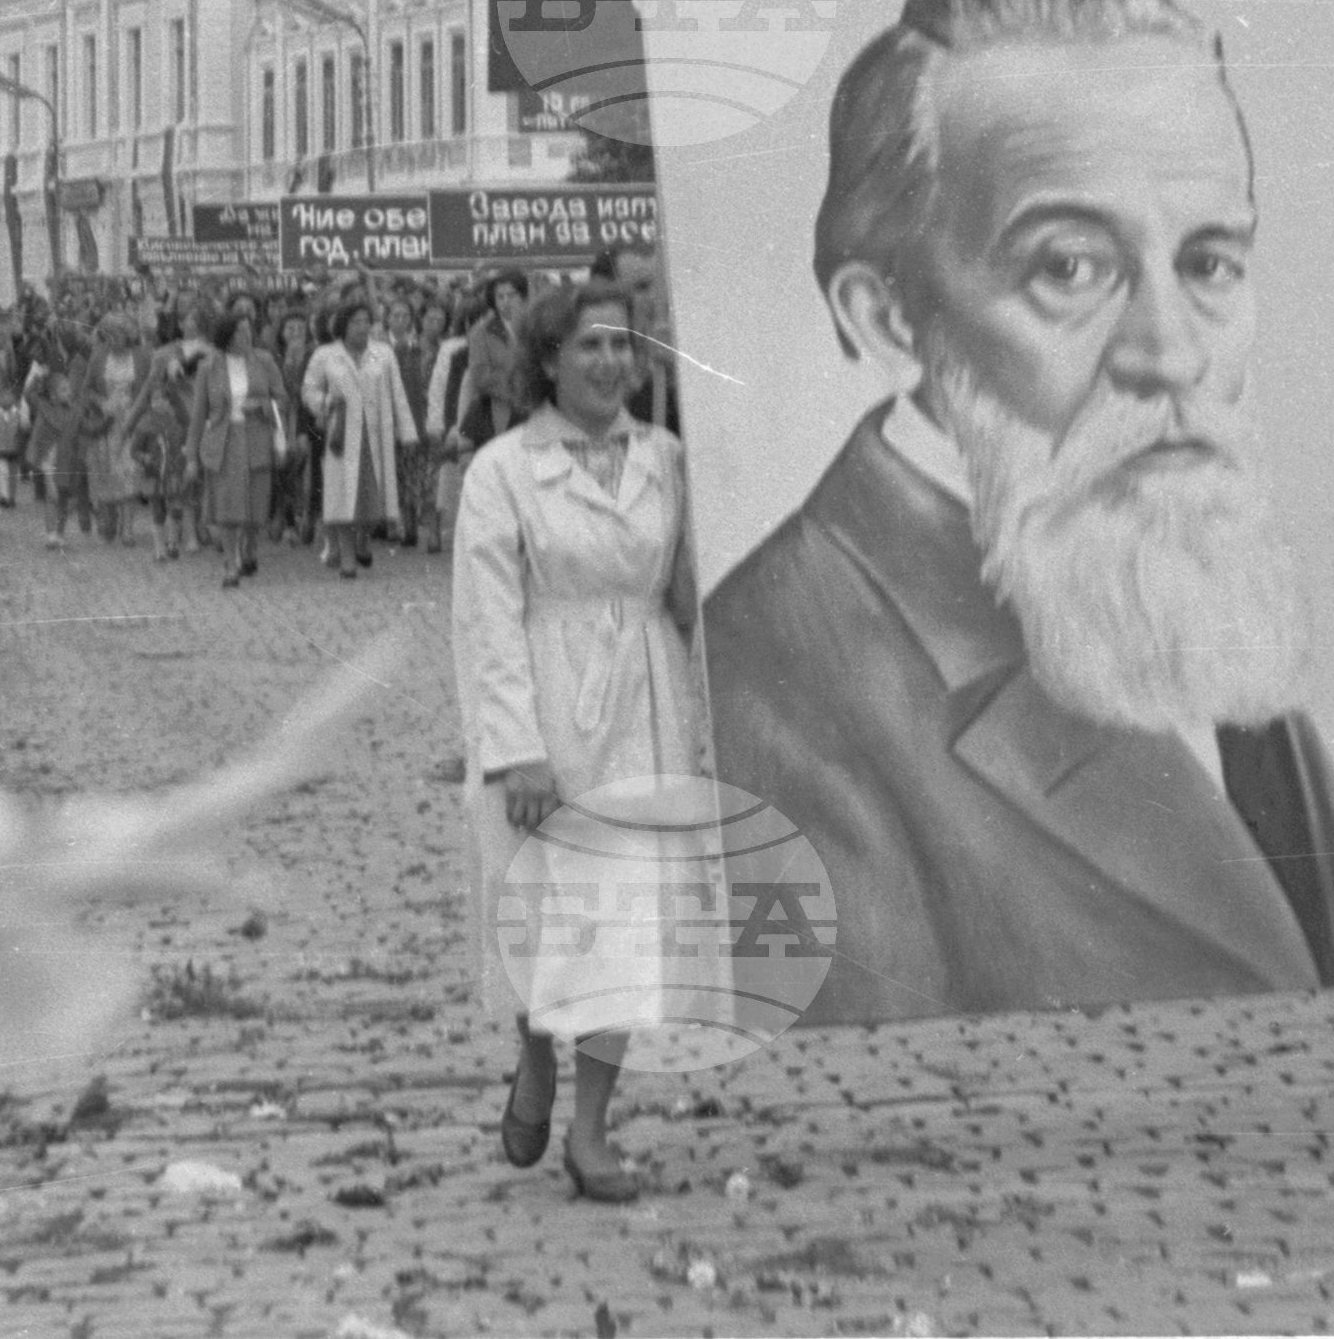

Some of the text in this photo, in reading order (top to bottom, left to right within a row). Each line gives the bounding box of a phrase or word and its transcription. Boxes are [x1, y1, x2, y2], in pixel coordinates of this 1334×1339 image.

[292, 203, 427, 231] Ние обе
[472, 221, 546, 246] план
[556, 221, 590, 245] за
[300, 235, 359, 266] год.
